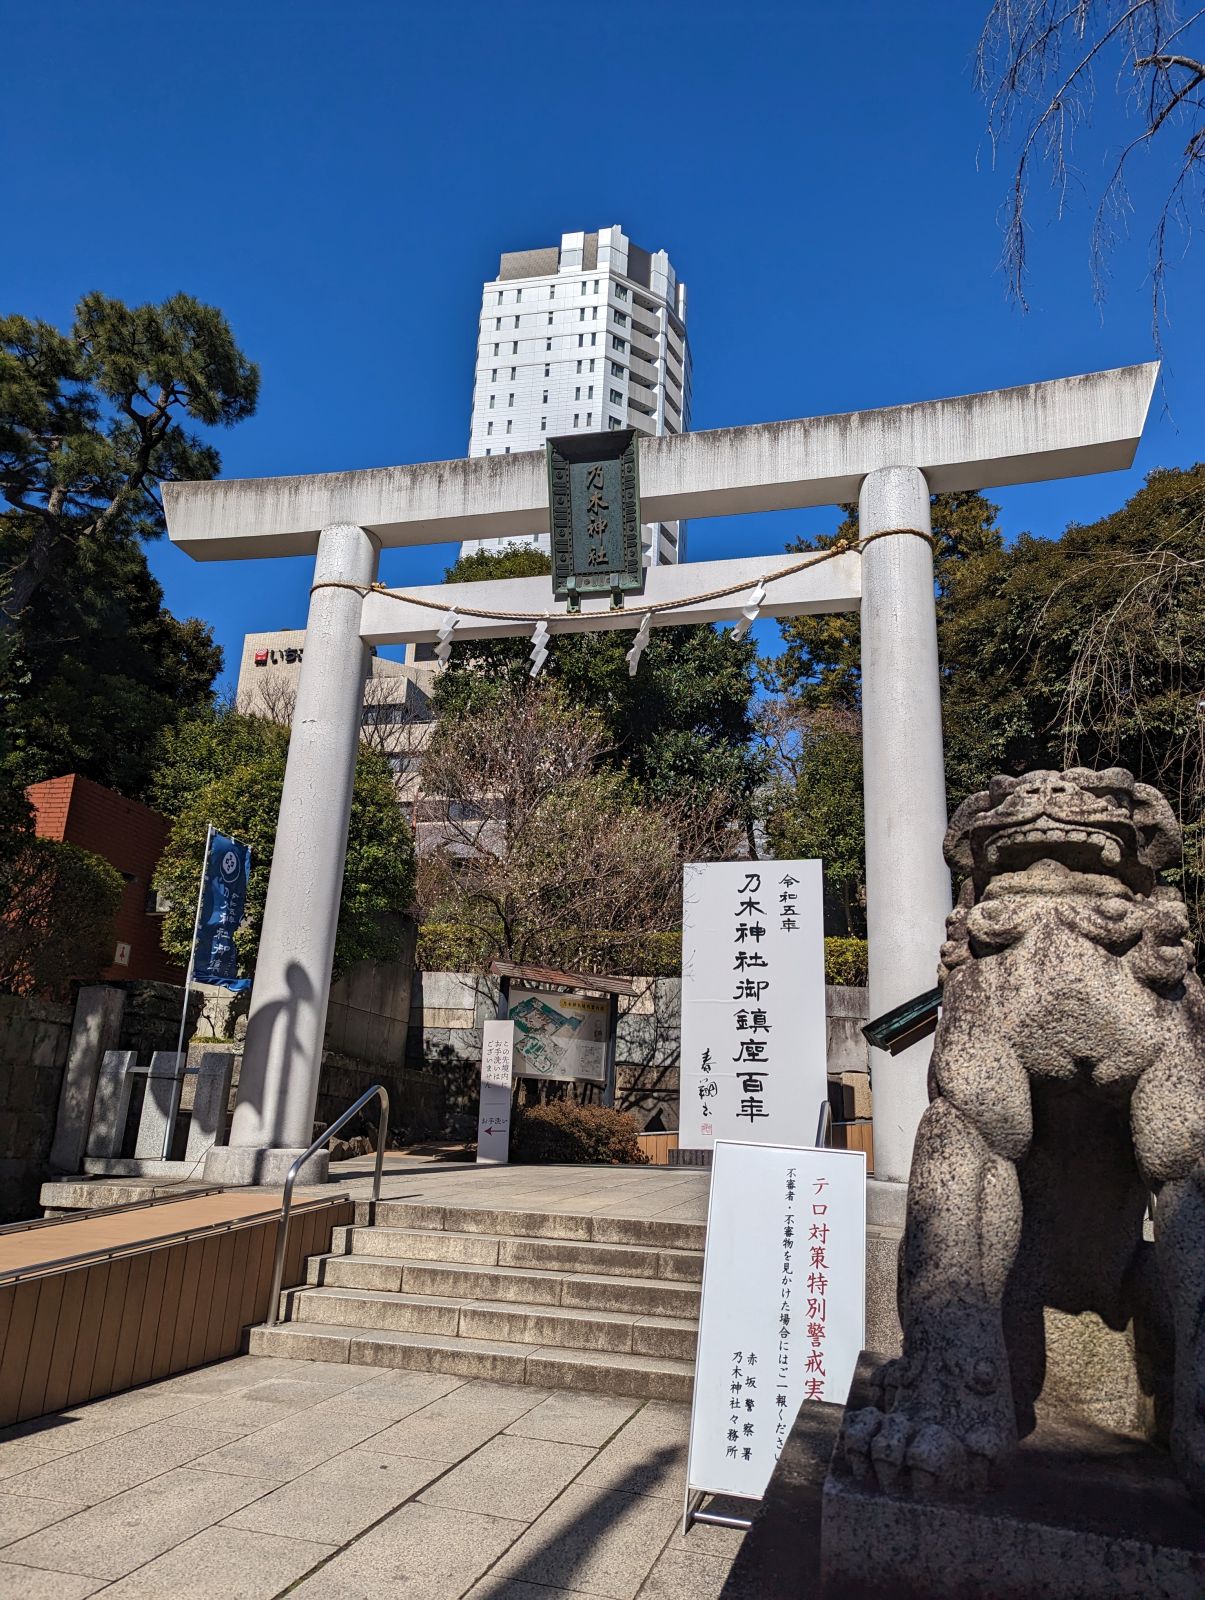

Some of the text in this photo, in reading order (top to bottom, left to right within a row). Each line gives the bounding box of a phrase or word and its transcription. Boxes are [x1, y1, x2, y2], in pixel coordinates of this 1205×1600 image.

[587, 464, 609, 566] 乃木神社
[779, 873, 800, 932] 令和五年
[732, 873, 772, 1123] 乃木神社御鎮座百年
[484, 1040, 494, 1090] ございません
[493, 1040, 502, 1081] お手洗いは
[500, 1040, 509, 1089] この先境内に
[481, 1117, 508, 1126] お手洗い
[725, 1351, 744, 1460] 乃木神社々務所
[740, 1352, 758, 1461] 赤坂警察署
